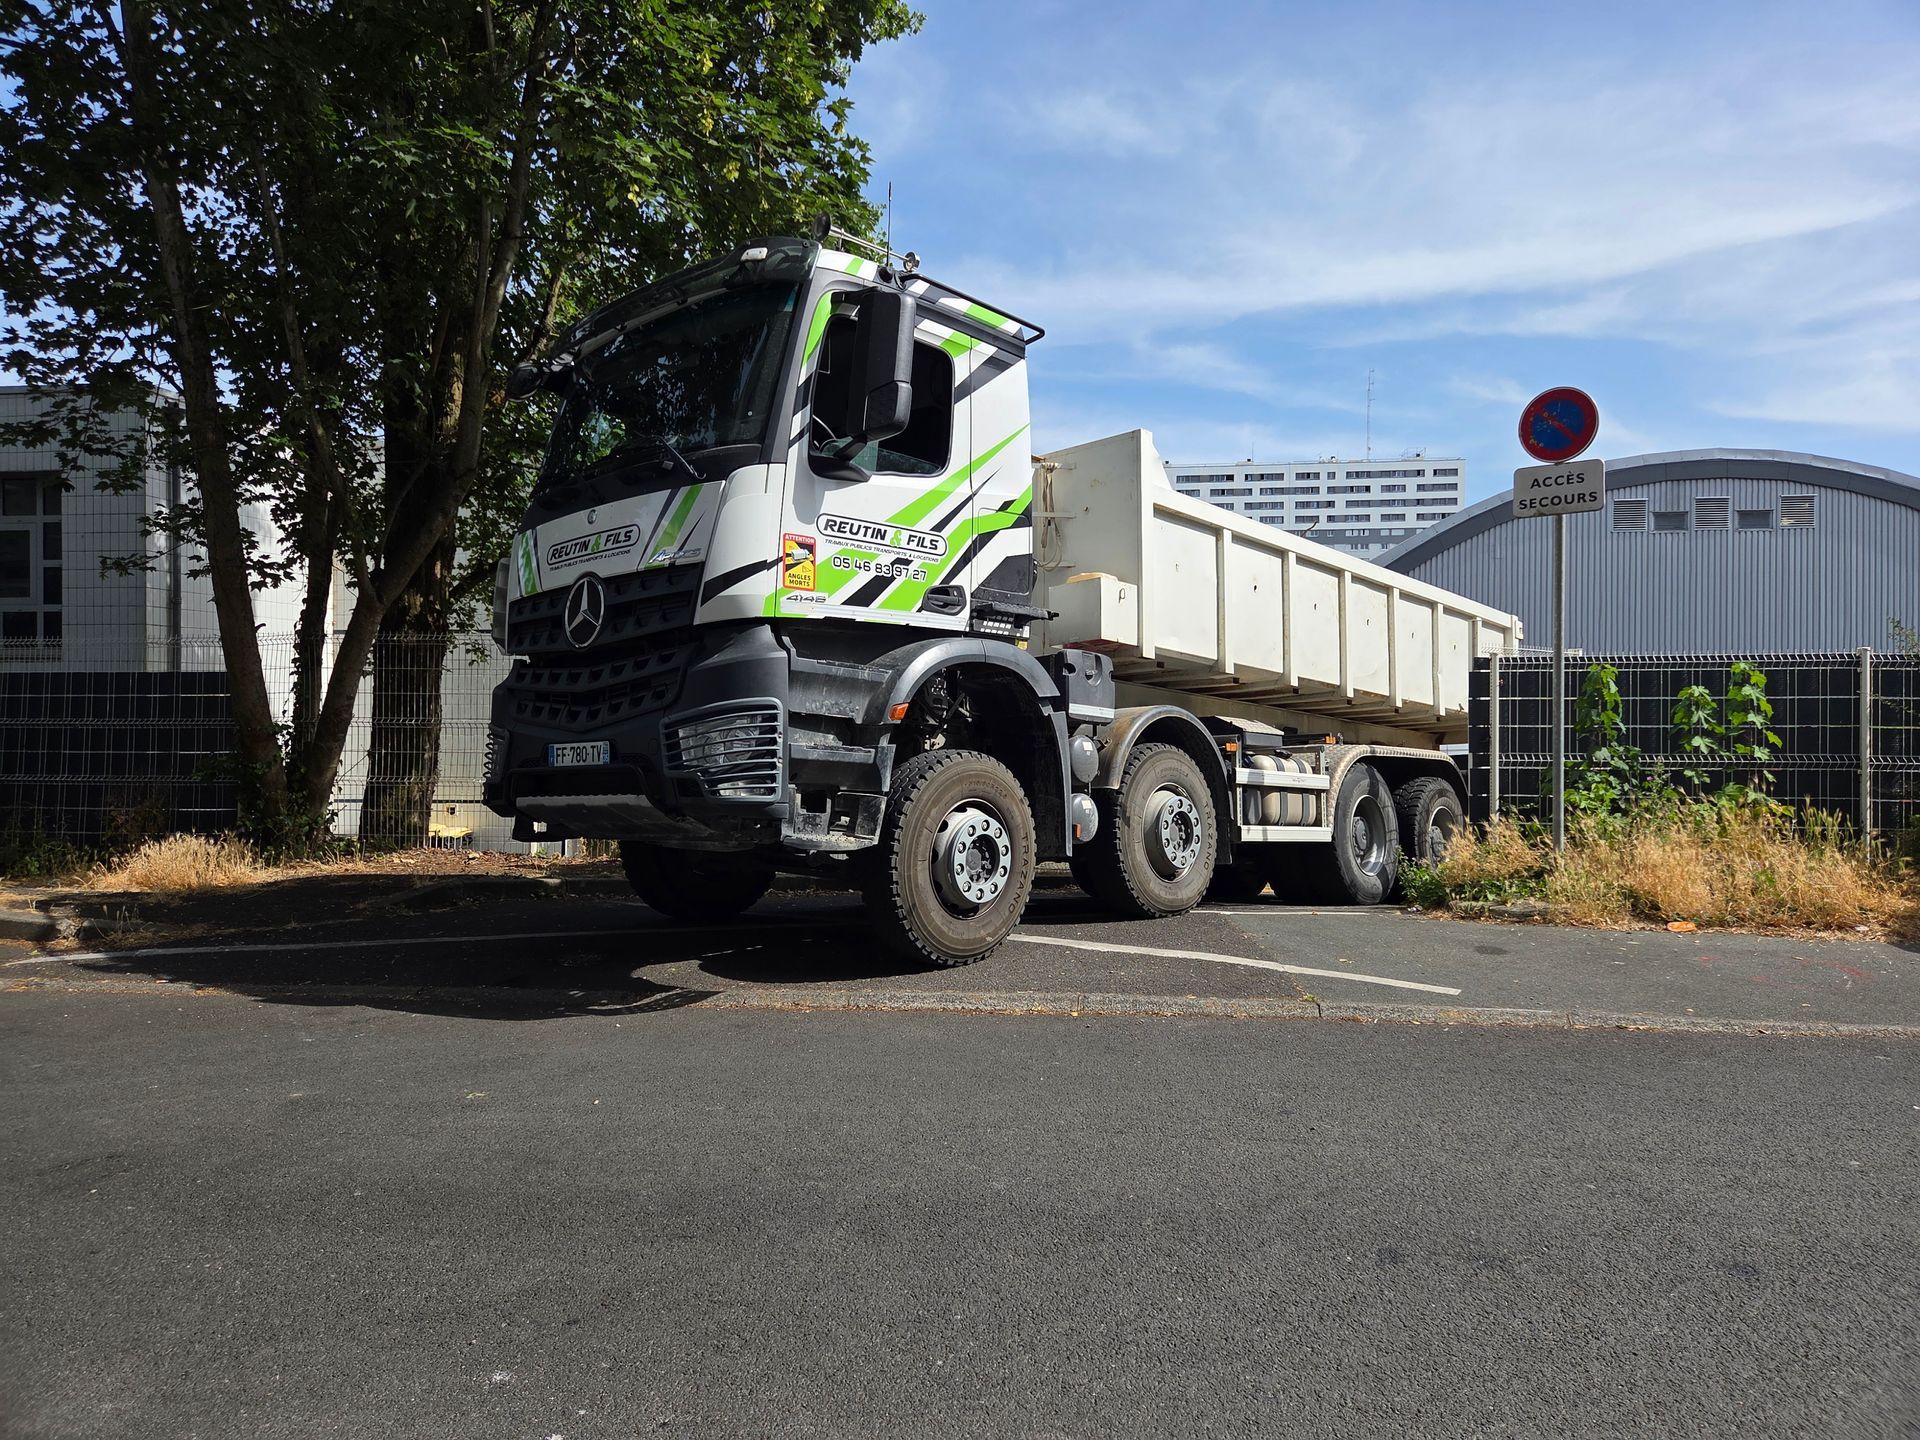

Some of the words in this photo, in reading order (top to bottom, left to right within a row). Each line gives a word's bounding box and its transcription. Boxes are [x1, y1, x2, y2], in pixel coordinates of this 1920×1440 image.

[1530, 471, 1585, 489] ACCÈS
[1519, 491, 1598, 510] SECOURS
[785, 534, 815, 543] ATTENTION
[823, 518, 888, 541] REUTIN
[890, 529, 902, 547] &
[906, 534, 939, 550] FILS
[550, 539, 591, 561] REUTIN
[591, 534, 601, 552] &
[604, 529, 634, 547] FILS
[873, 546, 907, 557] TRANSPORTS
[912, 554, 939, 562] LOCATIONS
[788, 573, 811, 581] ANGLES
[833, 556, 851, 569] 05
[854, 559, 871, 572] 46
[875, 563, 891, 575] 83
[894, 566, 909, 578] 97
[912, 569, 926, 581] 27
[789, 579, 810, 587] MORTS
[1203, 801, 1213, 870] TRAZANO
[1008, 832, 1030, 913] TRAZANO
